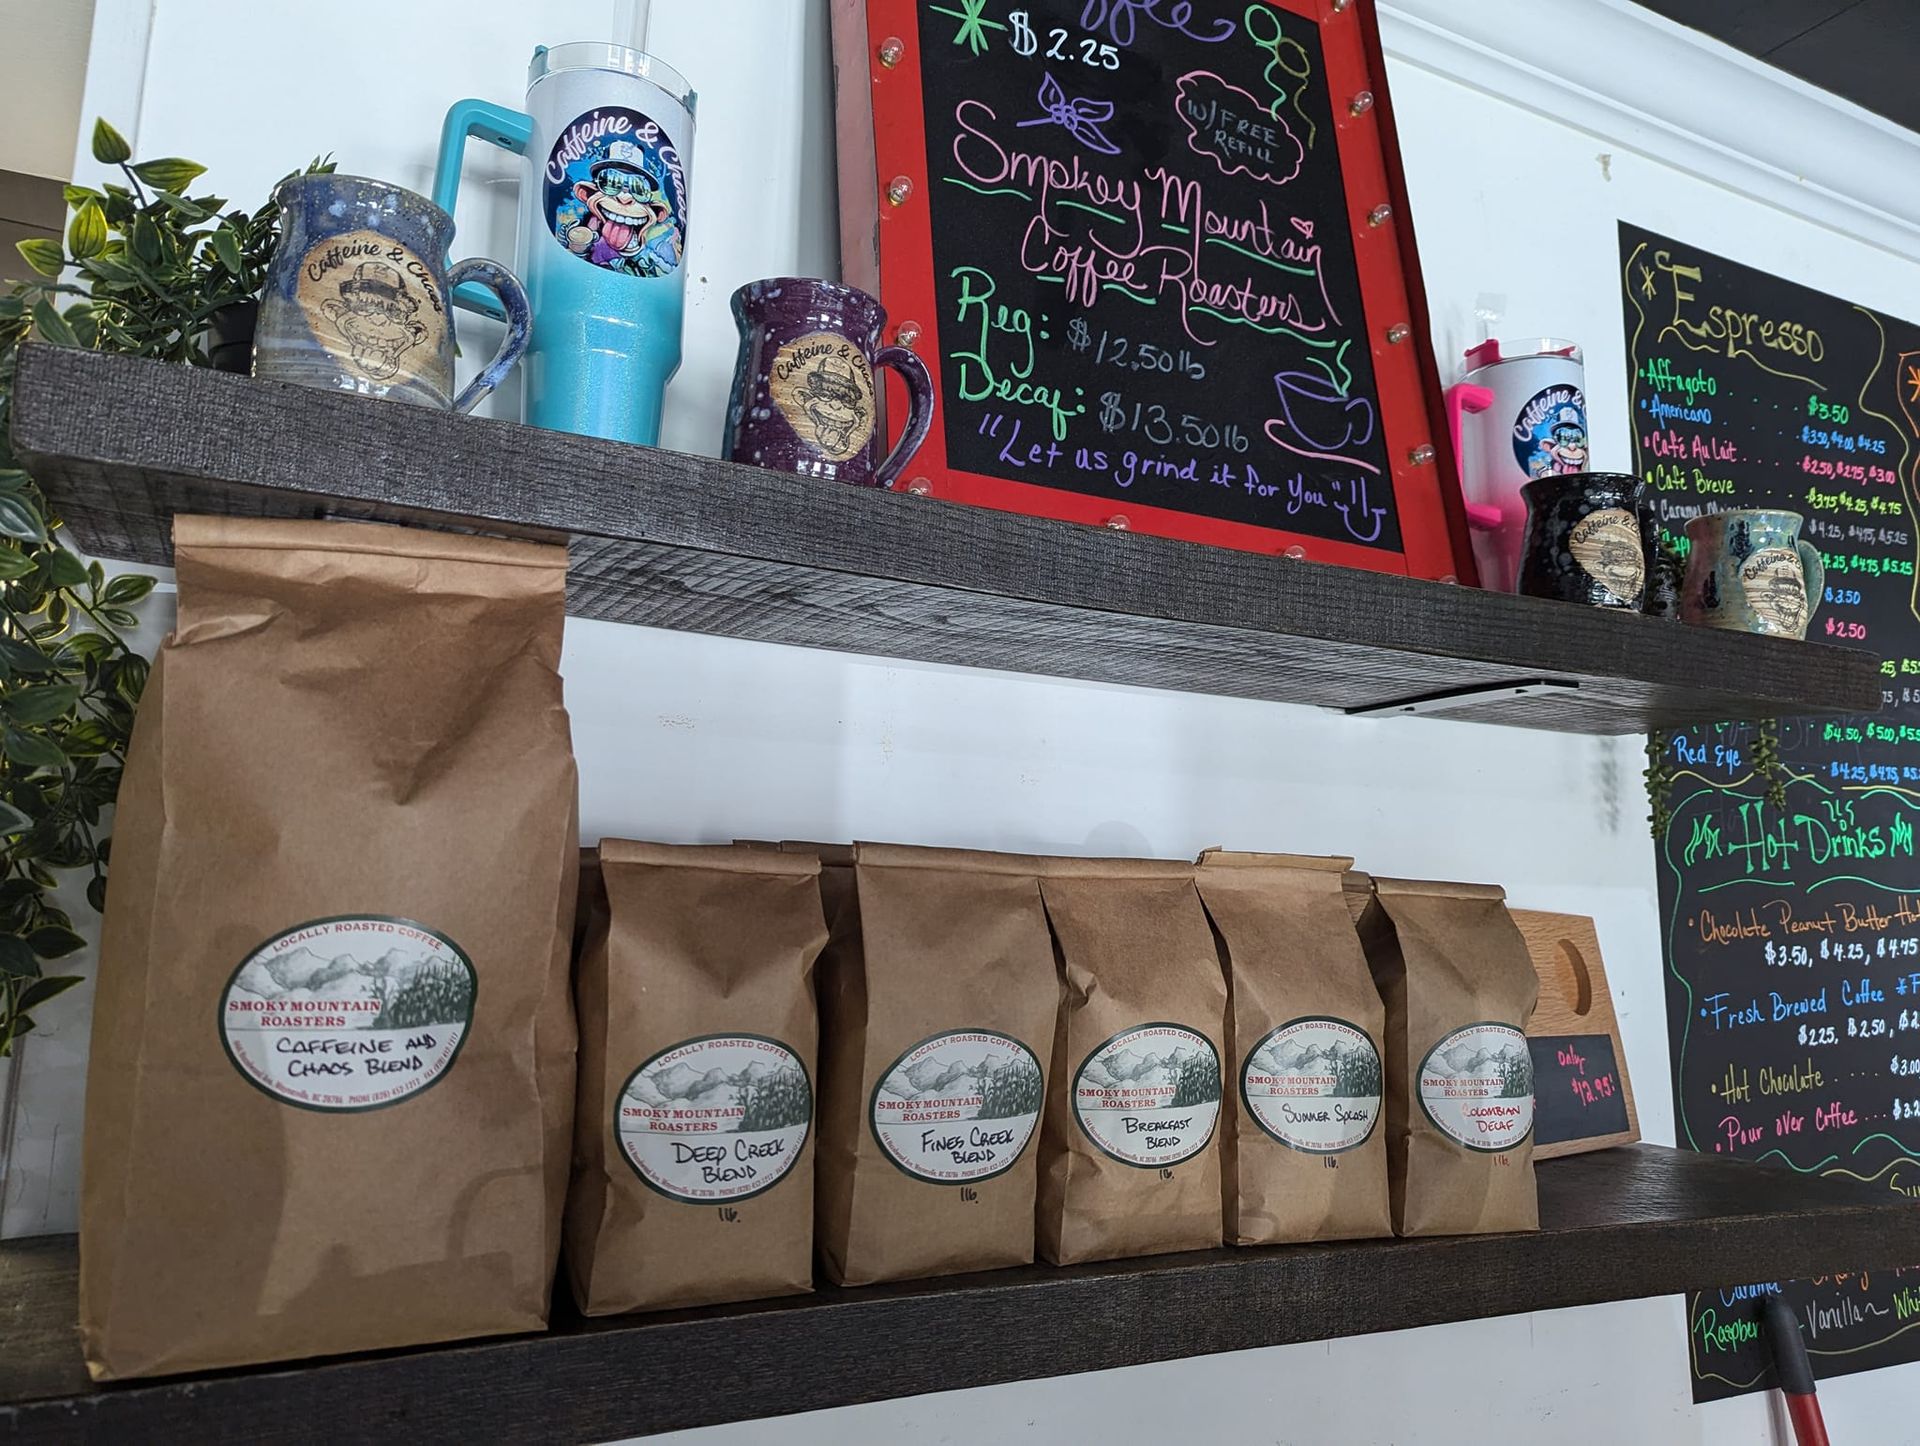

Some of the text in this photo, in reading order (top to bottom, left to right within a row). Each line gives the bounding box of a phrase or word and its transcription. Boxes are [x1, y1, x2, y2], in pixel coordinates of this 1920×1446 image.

[546, 111, 633, 186] Caffeine
[636, 122, 659, 149] &
[1214, 129, 1275, 164] REFILL
[953, 100, 1335, 300] Smokey Mountain
[308, 240, 442, 312] Caffeine & Chaos
[1021, 214, 1326, 346] Coffee Roasters
[1655, 251, 1824, 362] Espresso
[777, 341, 873, 397] Caffeine & Chaos
[1513, 389, 1571, 442] Caffeine
[1650, 393, 1712, 429] Americano
[1808, 395, 1849, 425] $3.50
[1652, 431, 1688, 458] Café
[1692, 434, 1710, 466] Au
[1076, 450, 1108, 471] us
[1124, 455, 1198, 488] grind
[1210, 467, 1237, 488] it
[1245, 464, 1280, 496] for
[1656, 464, 1689, 491] Café
[1695, 468, 1736, 494] Breve
[1575, 515, 1619, 544] Caffeine
[1744, 553, 1786, 580] Caffeine
[1824, 586, 1861, 606] $3.50
[1826, 617, 1867, 640] $2.50
[1673, 735, 1707, 765] Red
[1714, 745, 1742, 776] Eye
[1728, 800, 1887, 874] Hot Drinks
[1700, 909, 1772, 945] Chocolate
[1763, 899, 1838, 937] Peanut
[1835, 902, 1893, 933] Butter
[273, 922, 442, 953] LOCALLY ROASTED COFFEE
[229, 1000, 381, 1012] SMOKY MOUNTAIN
[1704, 992, 1766, 1030] Fresh
[1769, 987, 1828, 1022] Brewed
[1842, 978, 1885, 1006] Coffee
[261, 1016, 346, 1027] ROASTERS
[1274, 1025, 1303, 1043] LOCALLY
[1338, 1026, 1364, 1042] COFFEE
[277, 1037, 393, 1055] CAFFEINE
[910, 1034, 1022, 1062] LOCALLY ROASTED COFFEE
[1106, 1029, 1204, 1054] LOCALLY ROASTED COFFEE
[1446, 1030, 1474, 1046] LOCALLY
[1476, 1026, 1505, 1034] ROASTED
[288, 1059, 353, 1077] CHAOS
[366, 1054, 423, 1076] BLEND
[657, 1040, 789, 1067] LOCALLY ROASTED COFFEE
[1557, 1044, 1586, 1075] Only
[1078, 1087, 1175, 1097] SMOKY MOUNTAIN
[1247, 1076, 1336, 1085] SMOKY MOUNTAIN
[1423, 1078, 1505, 1086] SMOKY MOUNTAIN
[1444, 1088, 1488, 1096] ROASTERS
[1720, 1064, 1751, 1105] Hot
[1759, 1058, 1825, 1096] Chocolate
[623, 1106, 745, 1119] SMOKY MOUNTAIN
[878, 1097, 983, 1110] SMOKY MOUNTAIN
[902, 1110, 961, 1121] ROASTERS
[1102, 1099, 1156, 1108] ROASTERS
[1463, 1103, 1520, 1117] COLOMBIAN
[650, 1121, 718, 1131] ROASTERS
[921, 1129, 965, 1152] FINES
[970, 1126, 1015, 1147] CREEK
[1121, 1117, 1192, 1134] BREAKFAST
[1476, 1119, 1514, 1133] DECAF
[1718, 1115, 1764, 1153] Pour
[1815, 1102, 1858, 1132] Coffee
[671, 1142, 727, 1165] DEEP
[735, 1138, 785, 1161] CREEK
[1145, 1136, 1181, 1149] BLEND
[951, 1149, 996, 1164] BLEND
[702, 1165, 757, 1184] BLEND
[1806, 1293, 1863, 1339] Vanilla
